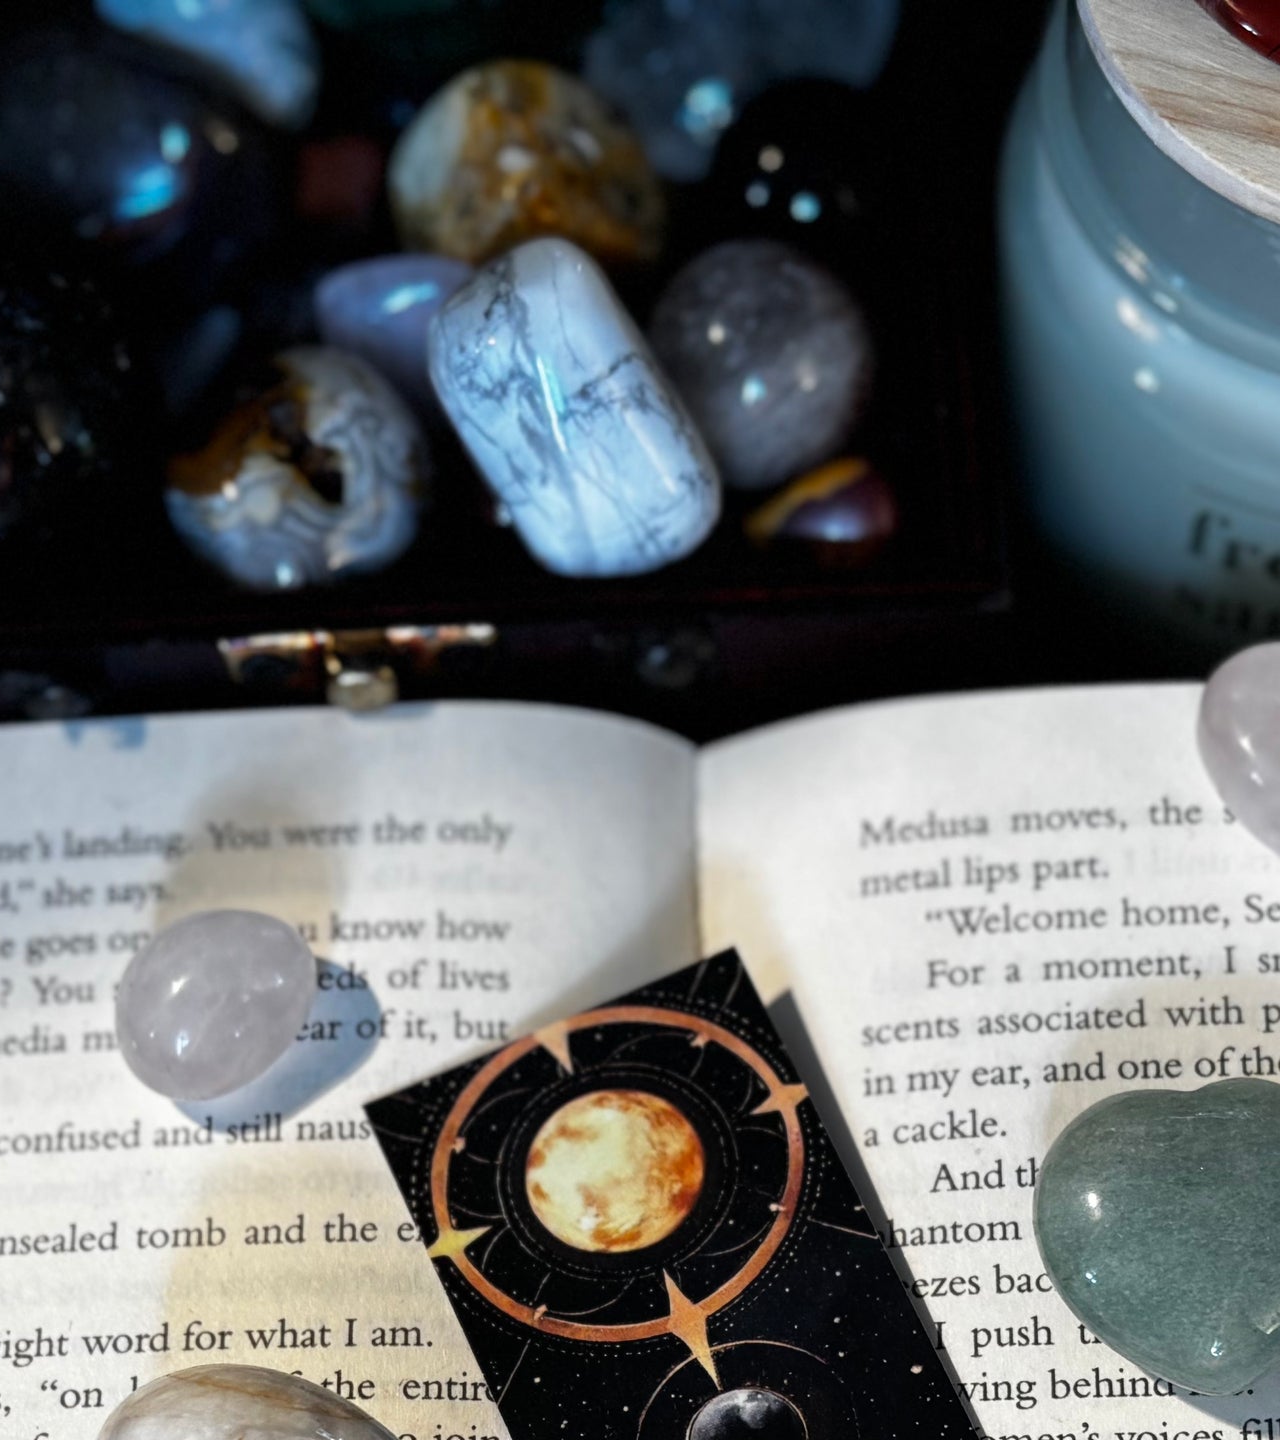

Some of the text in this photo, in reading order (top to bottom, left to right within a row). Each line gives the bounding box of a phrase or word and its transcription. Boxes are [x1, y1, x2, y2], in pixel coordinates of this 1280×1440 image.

[924, 901, 1109, 938] “Welcome
[1120, 895, 1232, 930] home,
[926, 958, 987, 991] For
[1003, 961, 1023, 985] a
[1041, 952, 1204, 983] moment,
[1222, 943, 1238, 976] I
[153, 1114, 216, 1147] and
[222, 1110, 284, 1144] still
[863, 1107, 1008, 1148] a cackle.
[80, 1320, 172, 1357] word
[180, 1319, 235, 1353] for
[243, 1316, 333, 1351] what
[343, 1316, 359, 1349] I
[369, 1325, 434, 1349] am.
